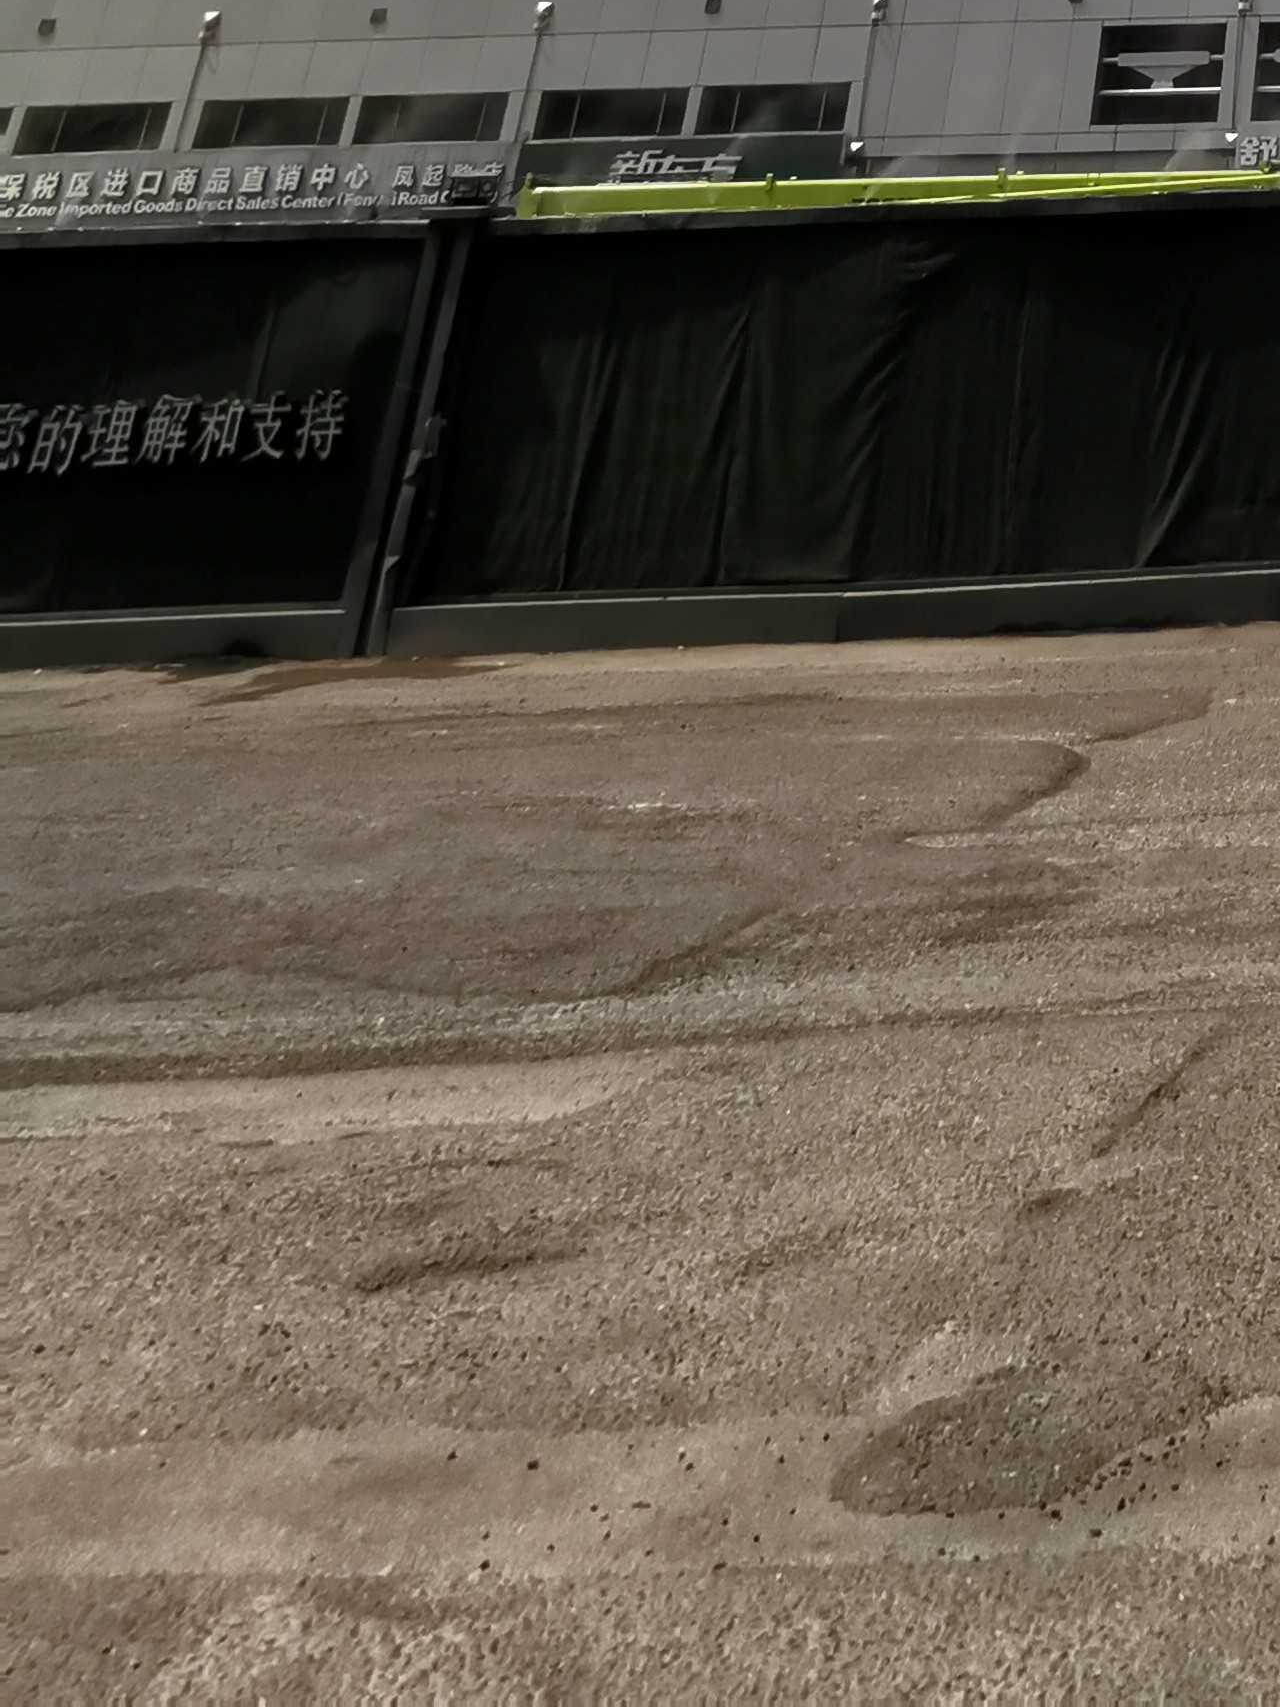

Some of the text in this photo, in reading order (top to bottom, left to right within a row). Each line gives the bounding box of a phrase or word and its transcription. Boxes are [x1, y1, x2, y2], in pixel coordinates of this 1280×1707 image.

[15, 202, 58, 218] Zone
[133, 197, 184, 214] Goods
[235, 195, 279, 211] Sales
[280, 193, 336, 210] Center
